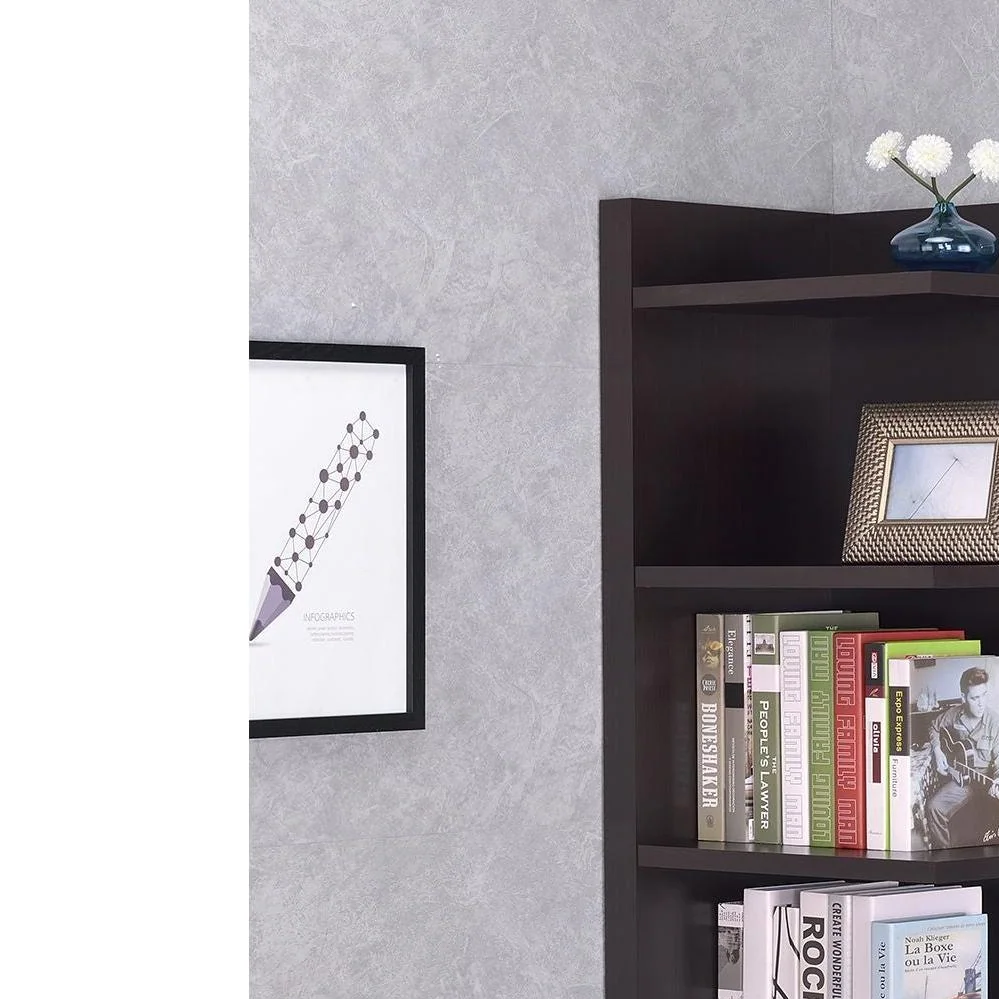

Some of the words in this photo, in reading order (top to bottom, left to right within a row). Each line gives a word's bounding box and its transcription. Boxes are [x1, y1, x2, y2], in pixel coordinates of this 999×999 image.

[304, 611, 355, 622] INFOGRAPHICS
[725, 629, 737, 676] Elegance
[783, 634, 800, 703] LOVING
[811, 635, 830, 681] MAN
[837, 637, 855, 706] LOVING
[894, 691, 903, 714] Expo
[760, 700, 769, 766] PEOPLE'S
[784, 711, 802, 785] FAMILY
[812, 691, 830, 765] FAMILY
[873, 723, 881, 753] olivia
[894, 715, 904, 752] Express
[701, 703, 718, 809] BONESHAKER
[837, 715, 856, 790] FAMILY
[760, 770, 769, 829] LAWYER
[891, 758, 899, 798] Furniture
[785, 795, 803, 840] MAN
[812, 773, 831, 842] LOVING
[838, 798, 857, 845] MAN
[832, 902, 842, 937] CREATE
[926, 934, 950, 943] Klieger
[832, 939, 842, 999] WONDERFUL
[878, 941, 886, 959] Vie
[878, 959, 886, 973] la
[905, 944, 921, 955] La
[924, 942, 954, 953] Boxe
[905, 958, 920, 967] ou
[924, 955, 934, 965] la
[938, 952, 957, 963] Vie
[880, 976, 886, 990] ou
